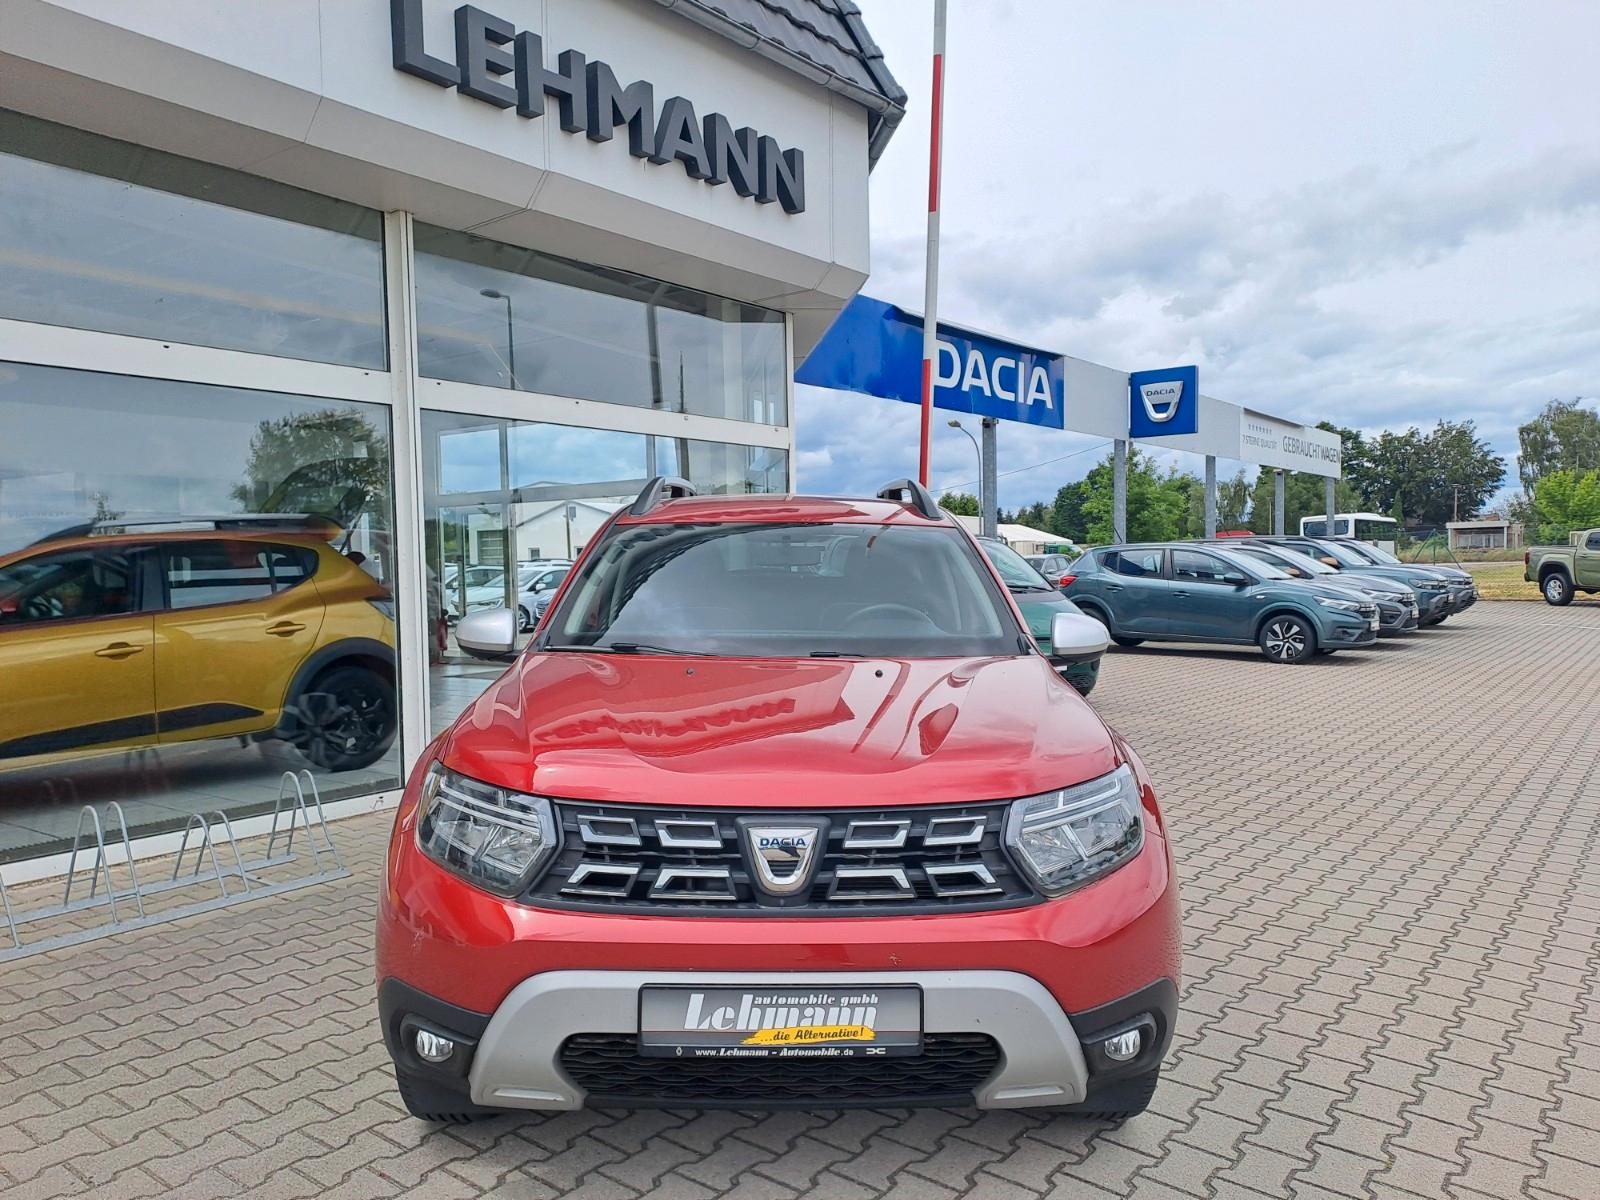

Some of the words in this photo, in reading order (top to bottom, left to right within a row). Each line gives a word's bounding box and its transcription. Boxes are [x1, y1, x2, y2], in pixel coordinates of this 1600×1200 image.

[391, 0, 805, 215] LEHMANN
[934, 339, 1053, 409] DACIA
[1146, 388, 1175, 397] DACIA
[1282, 435, 1341, 464] GEBRAUCHTWAGEN
[760, 838, 806, 847] DACIA
[754, 994, 836, 1005] automobile
[840, 994, 879, 1007] gmbh
[684, 993, 877, 1031] Lehmann
[794, 1027, 865, 1041] Alternative!
